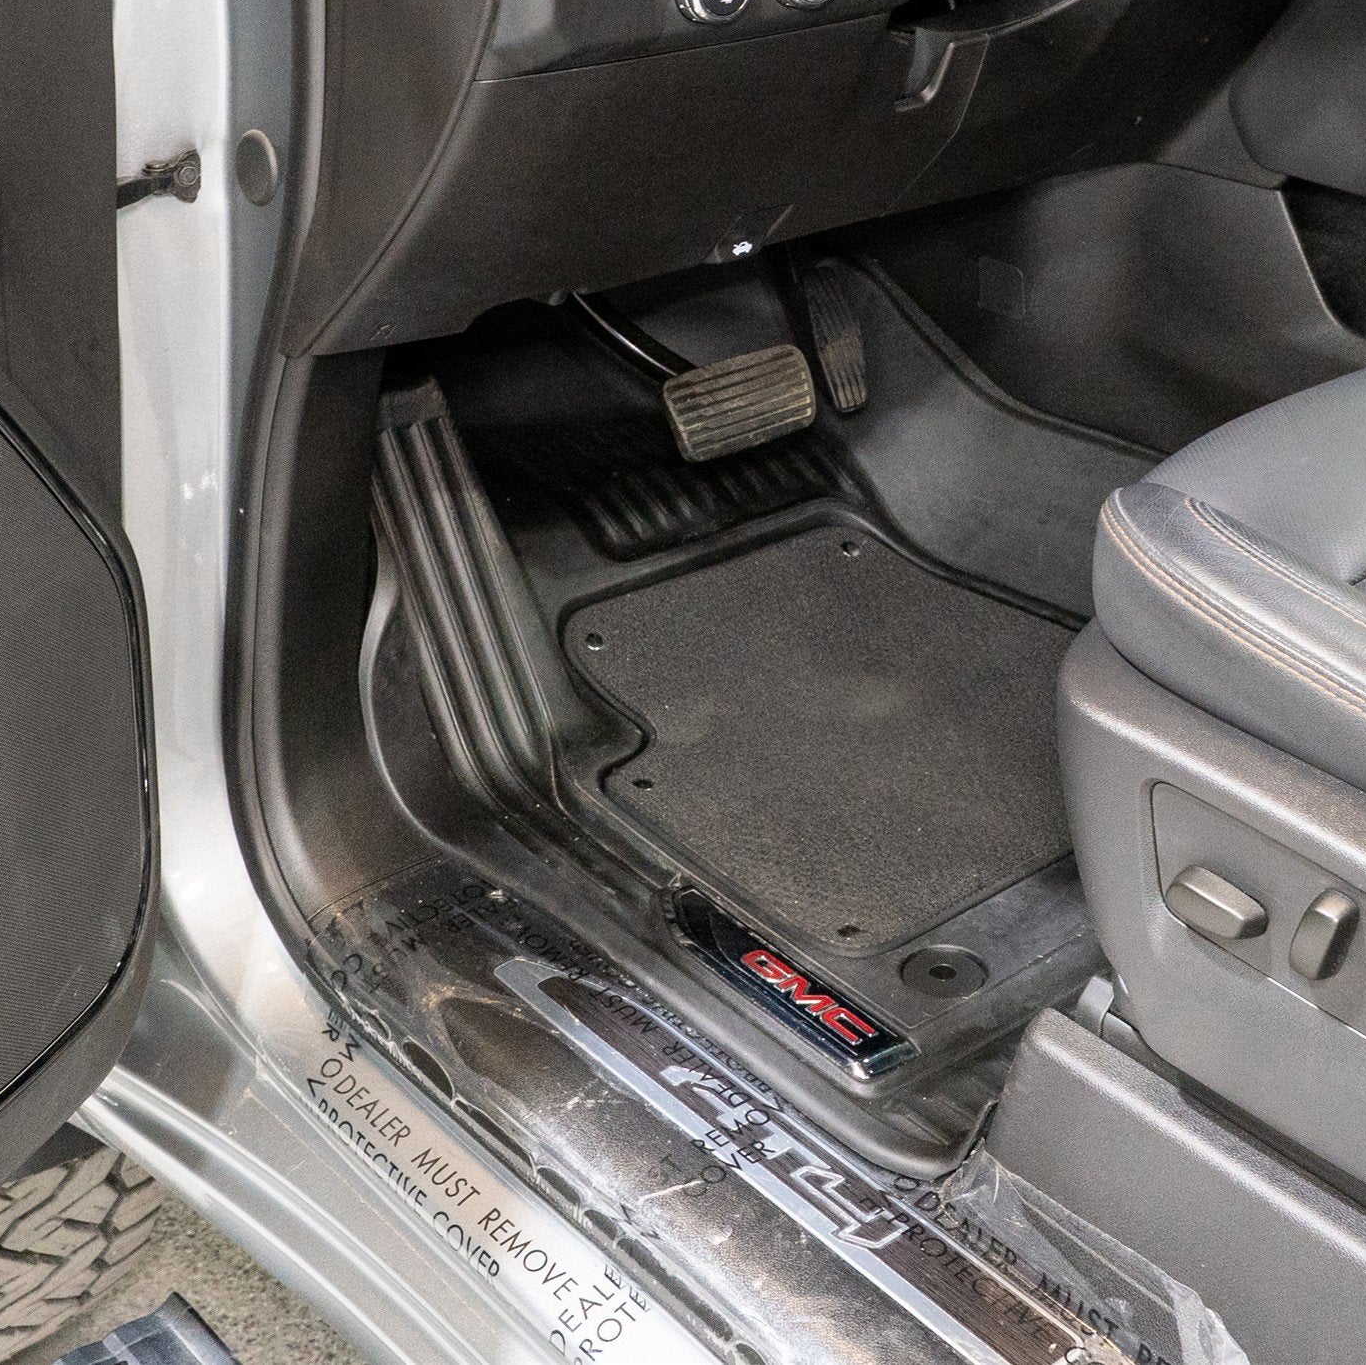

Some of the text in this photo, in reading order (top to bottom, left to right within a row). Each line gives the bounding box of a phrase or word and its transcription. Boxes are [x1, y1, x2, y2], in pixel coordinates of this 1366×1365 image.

[740, 949, 876, 1045] GMC
[663, 1040, 752, 1108] DEALER
[333, 1074, 578, 1301] DEALER MUST REMOVE
[549, 1263, 622, 1356] DEALE
